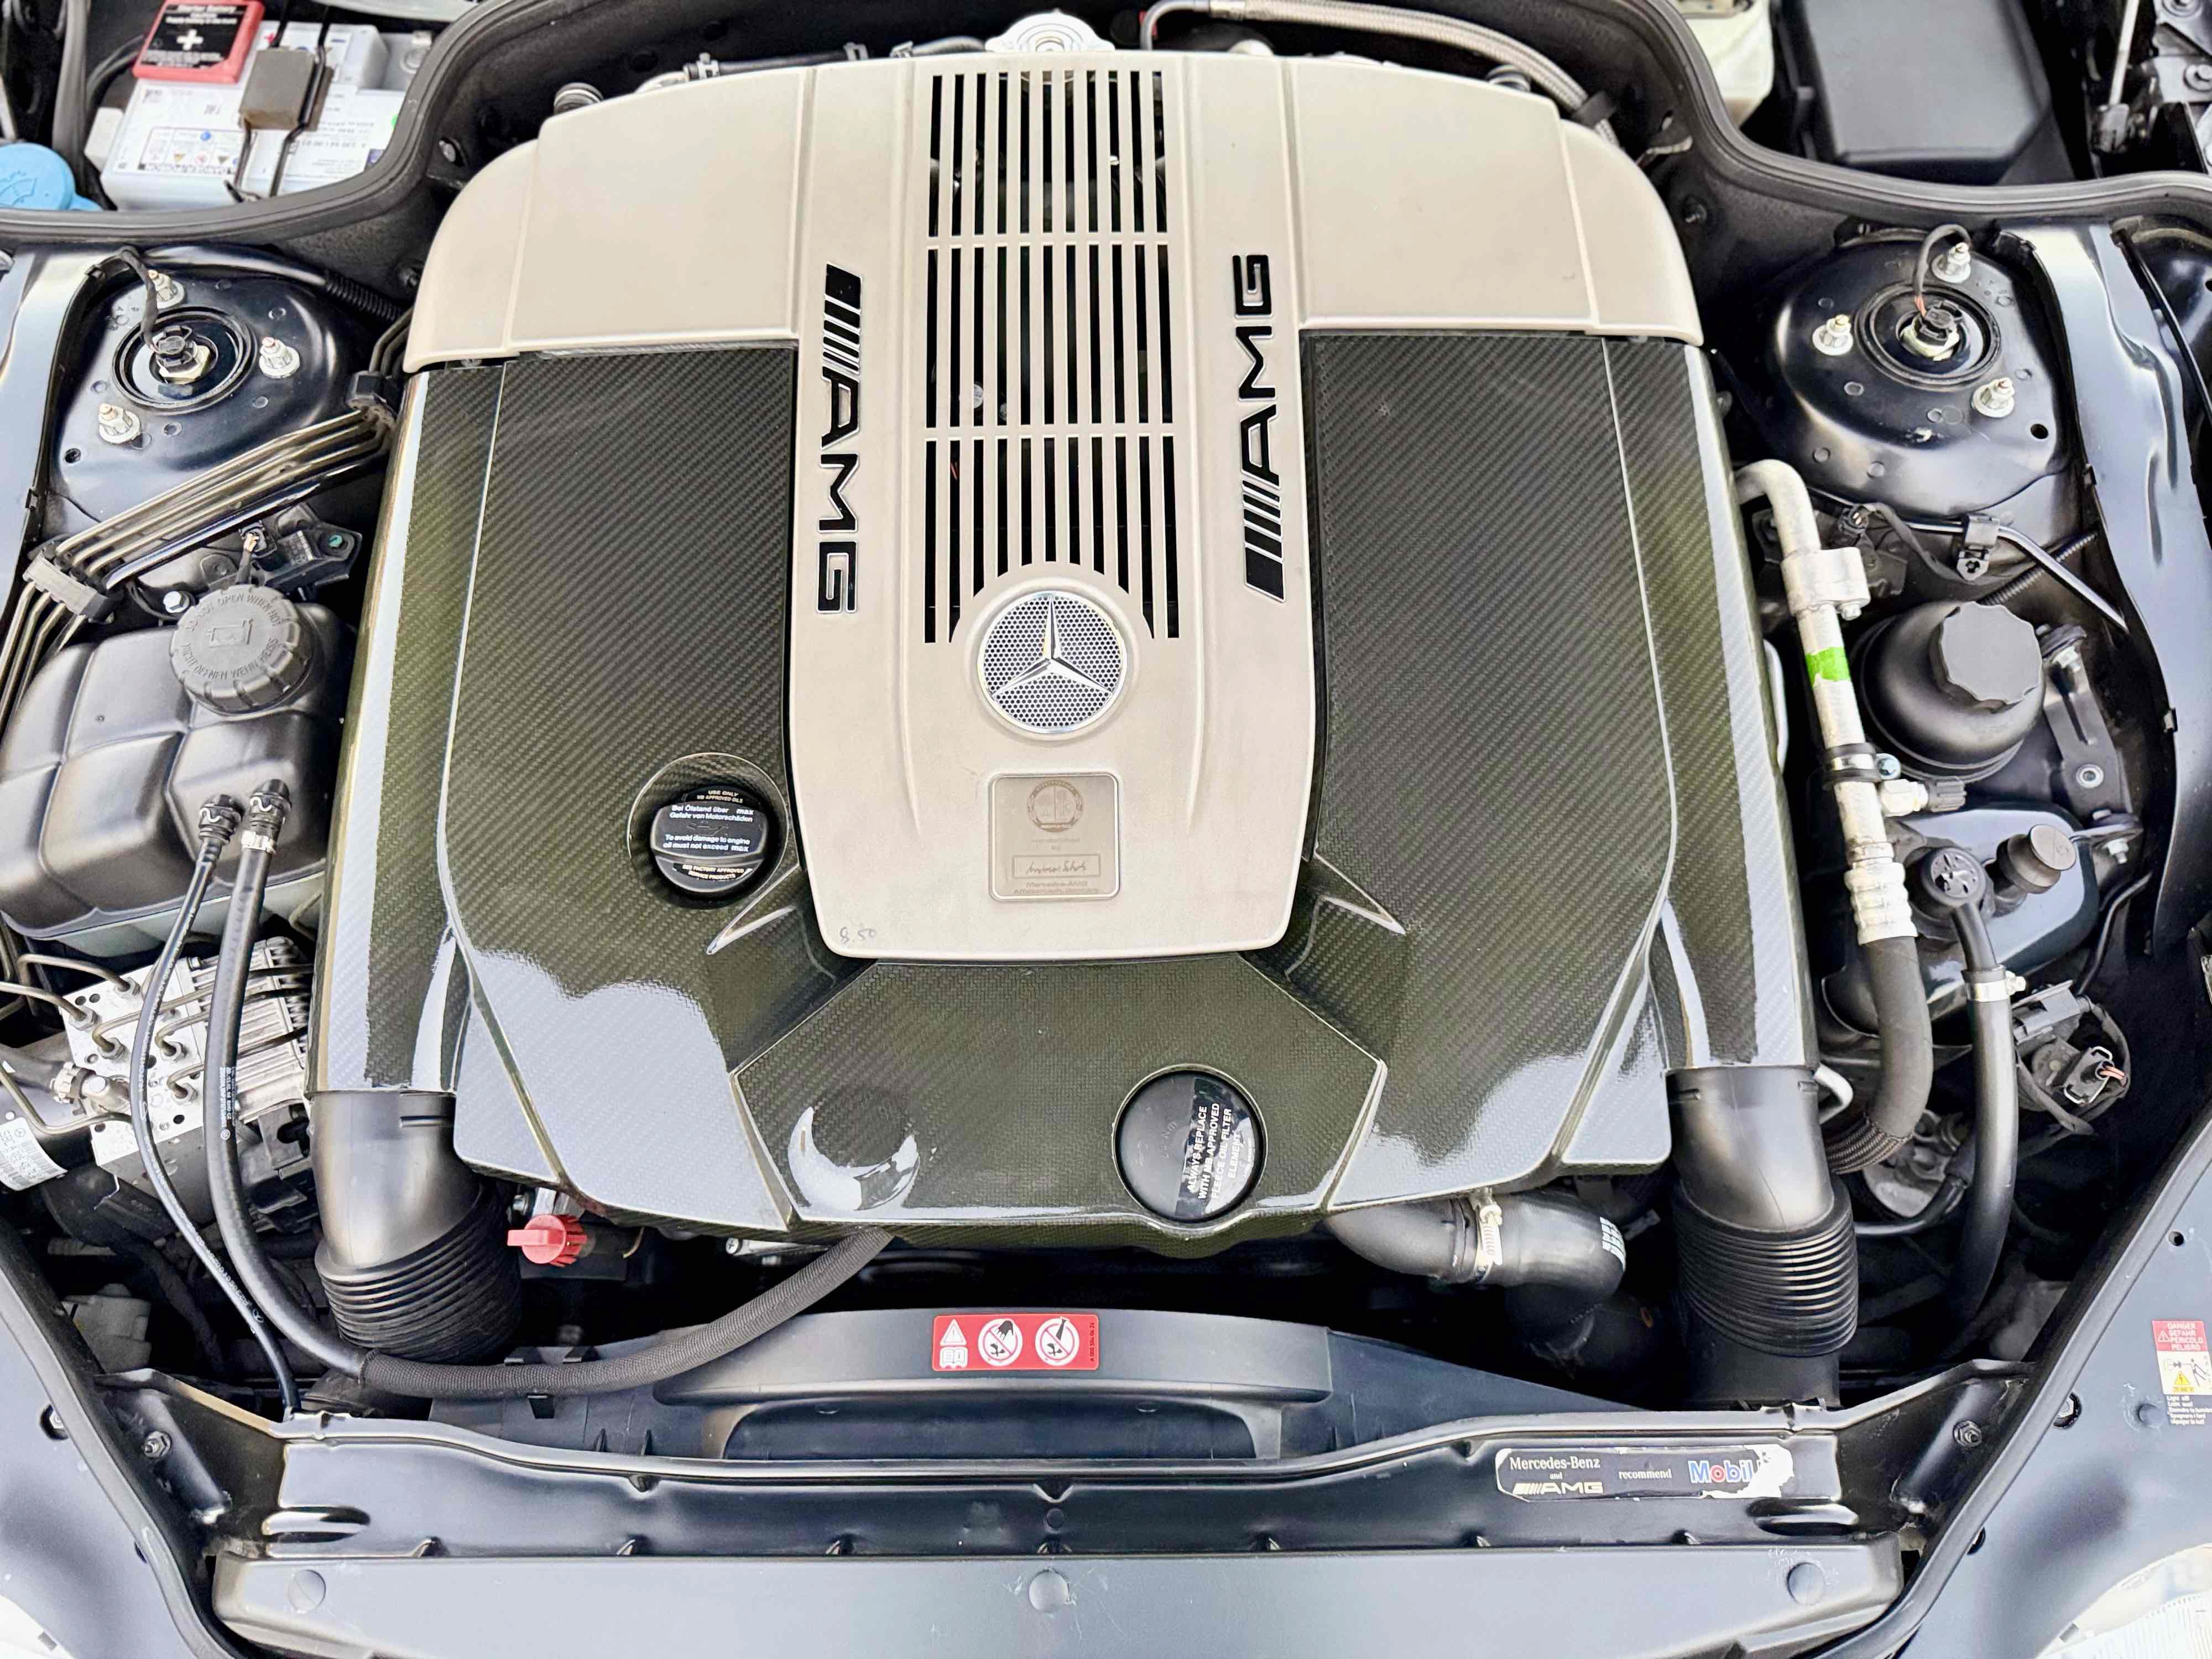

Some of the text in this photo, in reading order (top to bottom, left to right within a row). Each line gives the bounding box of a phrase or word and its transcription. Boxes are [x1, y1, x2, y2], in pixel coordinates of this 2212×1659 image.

[1232, 254, 1281, 488] AMG
[817, 367, 861, 613] AMG
[217, 592, 244, 604] OPEN
[685, 804, 712, 812] Ölstand
[706, 813, 753, 822] Motorschäden
[1187, 1106, 1207, 1193] ALWAYS REPLACE
[1198, 1172, 1211, 1199] WITH
[1206, 1103, 1220, 1156] APPROVED
[1211, 1108, 1232, 1199] FLEECE OIL FILTER
[1228, 1132, 1241, 1179] ELEMENT
[1509, 1455, 1673, 1480] Mercedes-Benz recommend
[1550, 1472, 1563, 1480] and
[1688, 1459, 1753, 1484] Mobil
[1540, 1481, 1604, 1494] AMG
